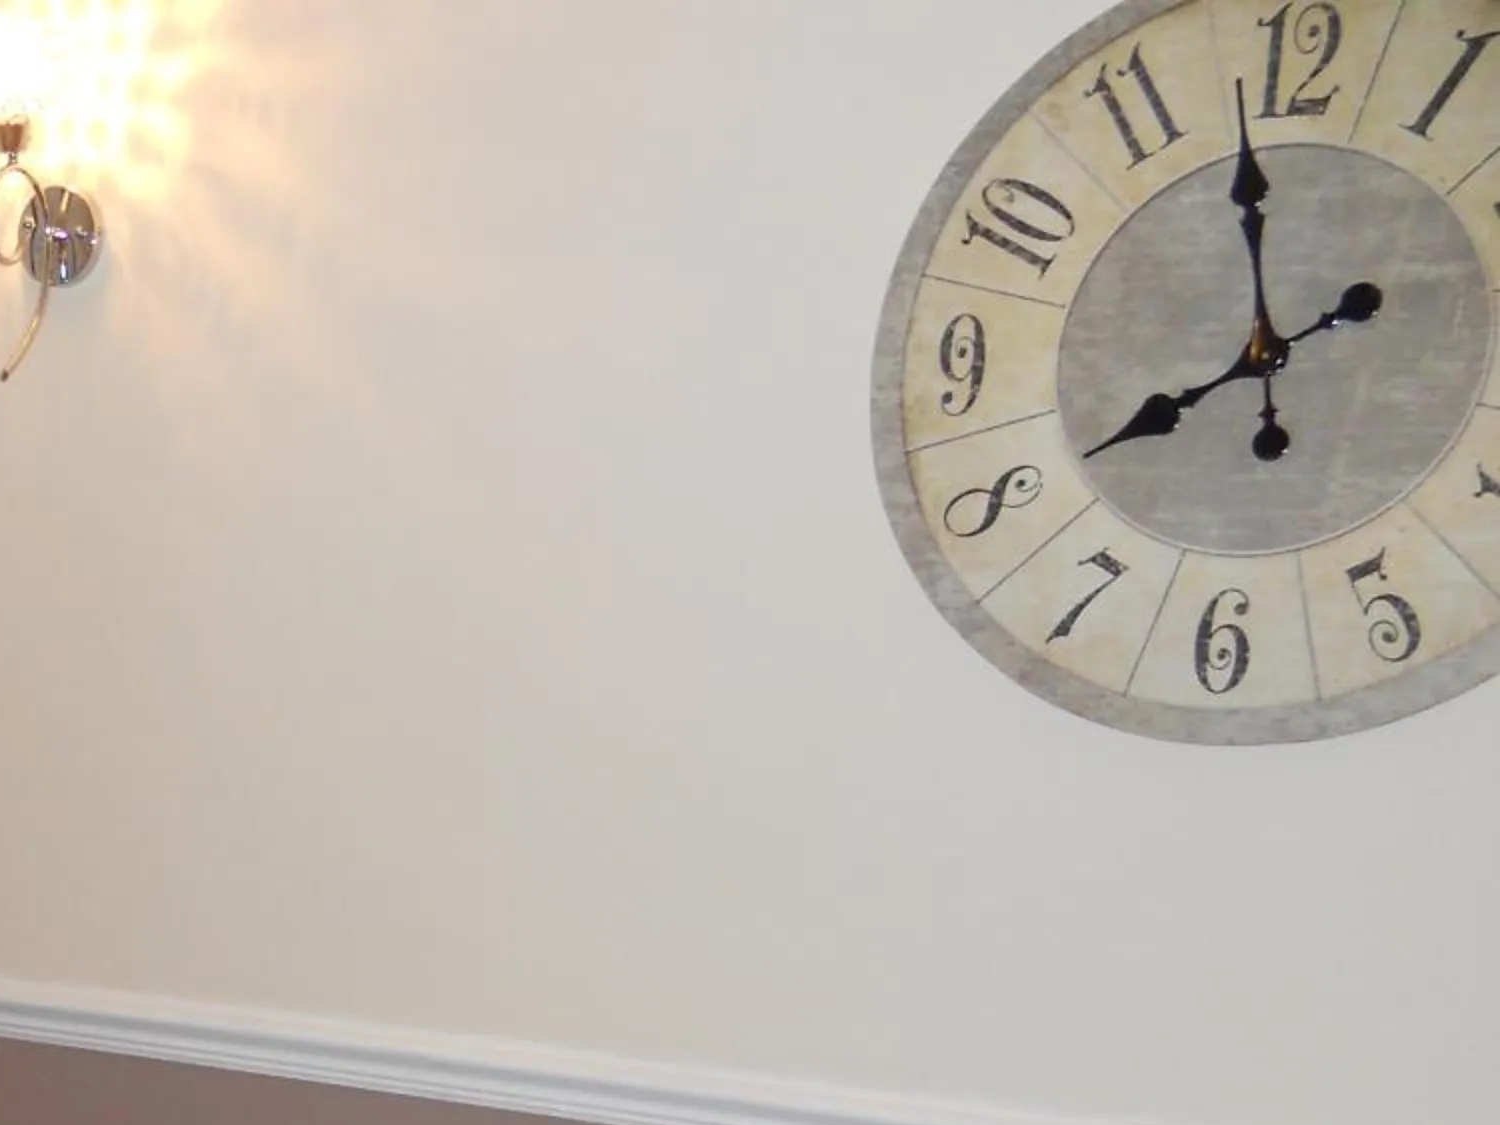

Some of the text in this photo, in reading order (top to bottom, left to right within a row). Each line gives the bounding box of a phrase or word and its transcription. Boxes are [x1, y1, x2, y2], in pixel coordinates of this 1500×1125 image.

[1084, 42, 1189, 170] 11
[1256, 1, 1343, 119] 12
[962, 177, 1076, 278] 10
[939, 314, 987, 416] 9
[943, 465, 1043, 538] 8
[1045, 547, 1129, 644] 7
[1195, 588, 1251, 694] 6
[1346, 547, 1422, 662] 5
